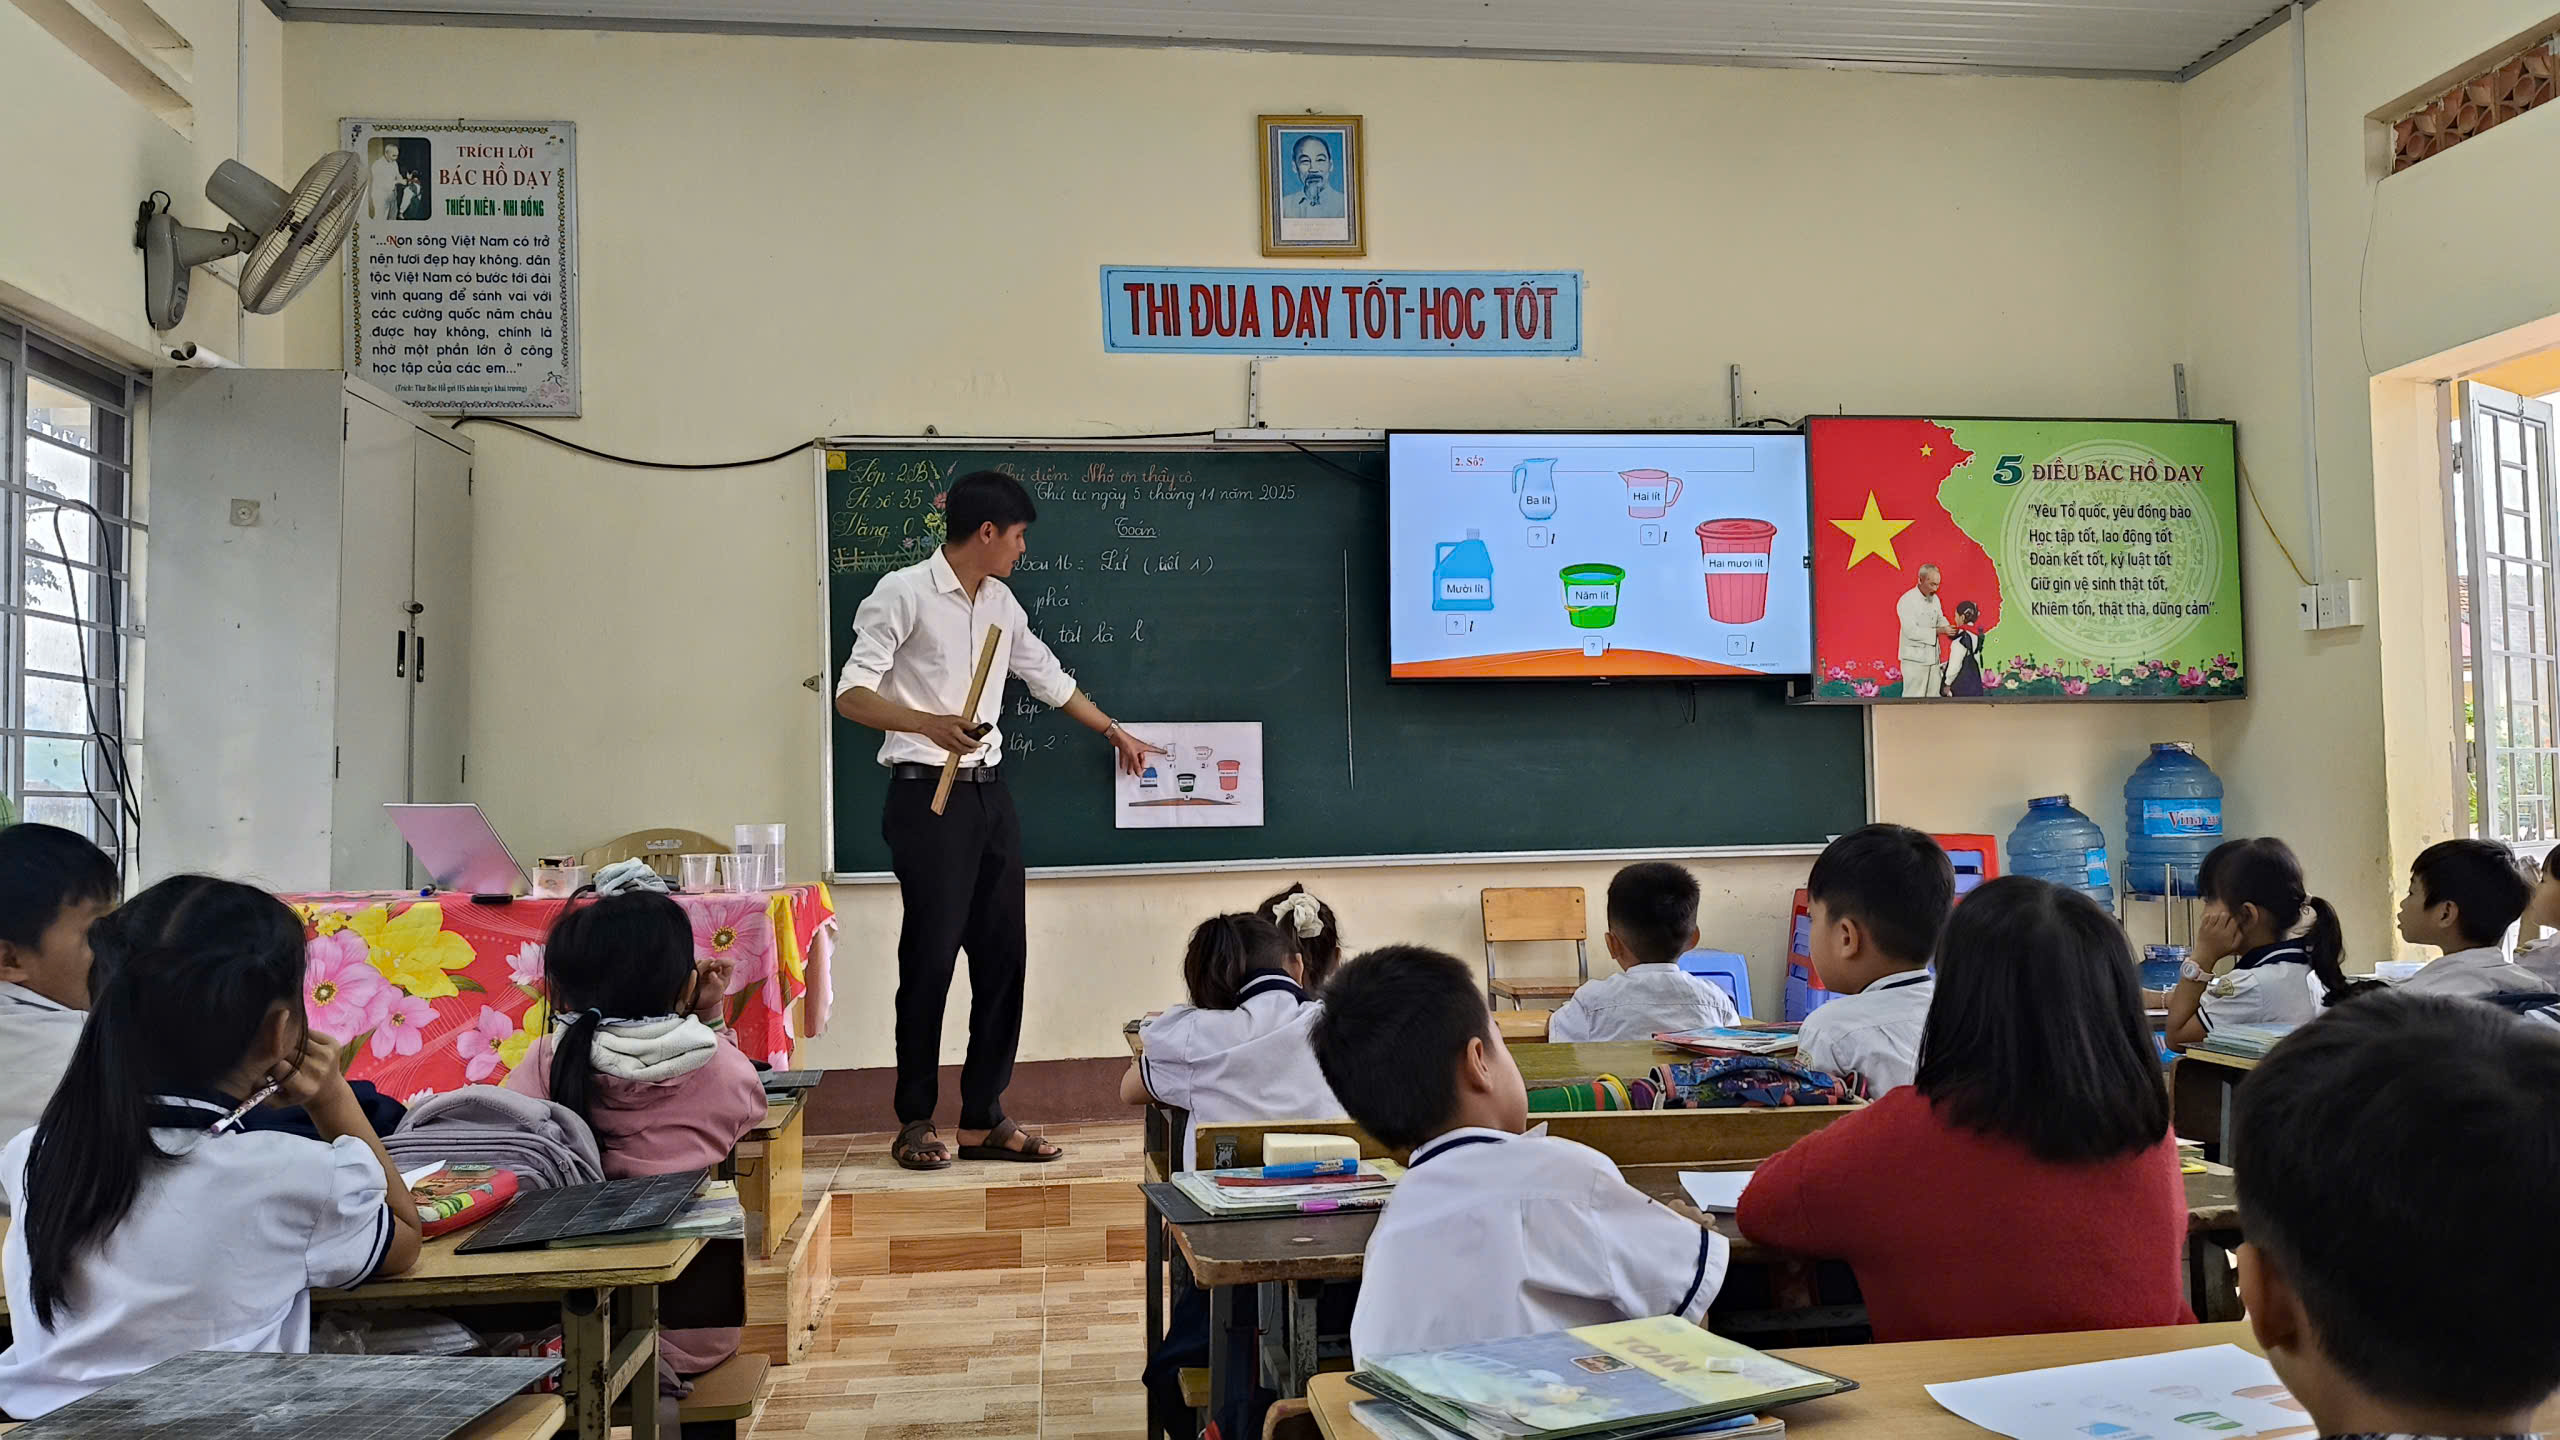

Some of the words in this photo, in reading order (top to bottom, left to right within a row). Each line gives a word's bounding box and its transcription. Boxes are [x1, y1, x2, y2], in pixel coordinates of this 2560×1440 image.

[456, 144, 504, 158] TRÍCH
[509, 144, 534, 158] LỜI
[440, 164, 477, 185] BÁC
[482, 162, 508, 185] HỒ
[513, 170, 552, 190] DẠY
[445, 194, 471, 216] THIẾU
[474, 196, 495, 216] NIÊN
[503, 200, 518, 216] NHI
[417, 235, 447, 248] sông
[451, 235, 475, 248] Việt
[480, 236, 509, 247] Nam
[513, 236, 529, 247] có
[534, 235, 550, 247] trở
[370, 253, 393, 264] nên
[398, 254, 420, 264] tươi
[424, 254, 449, 267] đẹp
[453, 254, 475, 267] hay
[526, 255, 551, 266] dân
[370, 272, 391, 285] tộc
[395, 272, 419, 285] Việt
[423, 272, 452, 282] Nam
[456, 272, 472, 283] có
[476, 272, 508, 283] bước
[512, 272, 527, 283] tới
[531, 272, 551, 283] đài
[371, 290, 396, 300] vinh
[403, 292, 443, 303] quang
[449, 287, 466, 301] để
[473, 290, 502, 301] sánh
[509, 291, 527, 301] vai
[533, 290, 551, 302] với
[371, 307, 397, 319] các
[402, 307, 443, 321] cường
[448, 307, 481, 321] quốc
[487, 308, 514, 319] năm
[520, 309, 552, 319] châu
[1123, 282, 1181, 337] THI
[1189, 284, 1261, 338] ĐUA
[1271, 285, 1332, 347] DẠY
[1494, 281, 1557, 340] TỐT
[372, 326, 405, 339] được
[414, 326, 437, 339] hay
[446, 326, 489, 340] không,
[498, 326, 532, 338] chính
[541, 326, 552, 338] là
[372, 343, 396, 355] nhờ
[404, 344, 429, 357] một
[436, 342, 469, 357] phần
[477, 344, 496, 355] lớn
[504, 342, 512, 355] ở
[520, 344, 553, 359] công
[373, 362, 397, 376] học
[401, 362, 423, 375] tập
[427, 360, 452, 373] của
[456, 362, 481, 373] các
[1455, 457, 1464, 466] 2.
[1993, 454, 2025, 486] 5
[2032, 457, 2079, 481] ĐIỀU
[2085, 460, 2125, 482] BÁC
[2129, 458, 2158, 482] HỒ
[2164, 465, 2204, 486] DẠY
[896, 460, 929, 483] 2B
[1082, 463, 1114, 483] Nhớ
[1121, 471, 1137, 483] ơn
[1143, 464, 1175, 488] thầy
[899, 489, 923, 509] 35
[1035, 481, 1065, 501] Thứ
[1073, 488, 1087, 500] tư
[1091, 488, 1127, 510] ngày
[1133, 487, 1141, 500] 5
[1149, 483, 1195, 510] tháng
[1200, 488, 1215, 500] 11
[1220, 488, 1254, 500] năm
[1259, 484, 1296, 500] 2025
[1526, 496, 1539, 504] Ba
[1542, 496, 1551, 504] lít
[1633, 492, 1649, 501] Hai
[1652, 491, 1660, 501] lít
[2060, 500, 2076, 518] Tổ
[2078, 502, 2109, 521] quốc,
[2112, 504, 2134, 521] yêu
[2137, 503, 2167, 521] đồng
[2170, 504, 2192, 518] bào
[904, 517, 914, 535] 0
[2029, 529, 2052, 545] Học
[2055, 528, 2075, 546] tập
[2078, 527, 2099, 544] tốt,
[2102, 529, 2119, 542] lao
[2122, 529, 2152, 546] động
[2155, 527, 2173, 543] tốt
[1709, 559, 1725, 568] Hai
[1728, 559, 1752, 568] mươi
[1754, 558, 1763, 568] lít
[2030, 551, 2060, 566] Đoàn
[2063, 550, 2084, 566] kết
[2087, 550, 2108, 567] tốt,
[2111, 551, 2125, 568] kỷ
[2127, 551, 2150, 569] luật
[2154, 550, 2172, 566] tốt
[1446, 584, 1472, 593] Mười
[1474, 584, 1484, 593] lít
[2031, 576, 2051, 591] Giữ
[2053, 576, 2071, 593] gìn
[2074, 576, 2089, 594] vệ
[2092, 577, 2116, 591] sinh
[2119, 576, 2144, 594] thật
[2147, 575, 2168, 592] tốt,
[1575, 591, 1598, 600] Năm
[1600, 590, 1609, 600] lít
[2031, 601, 2069, 616] Khiêm
[2072, 600, 2095, 617] tốn,
[2098, 601, 2124, 619] thật
[2126, 601, 2149, 616] thà,
[2152, 601, 2182, 618] dũng
[1092, 621, 1115, 643] là
[1613, 1335, 1702, 1373] TOÁN
